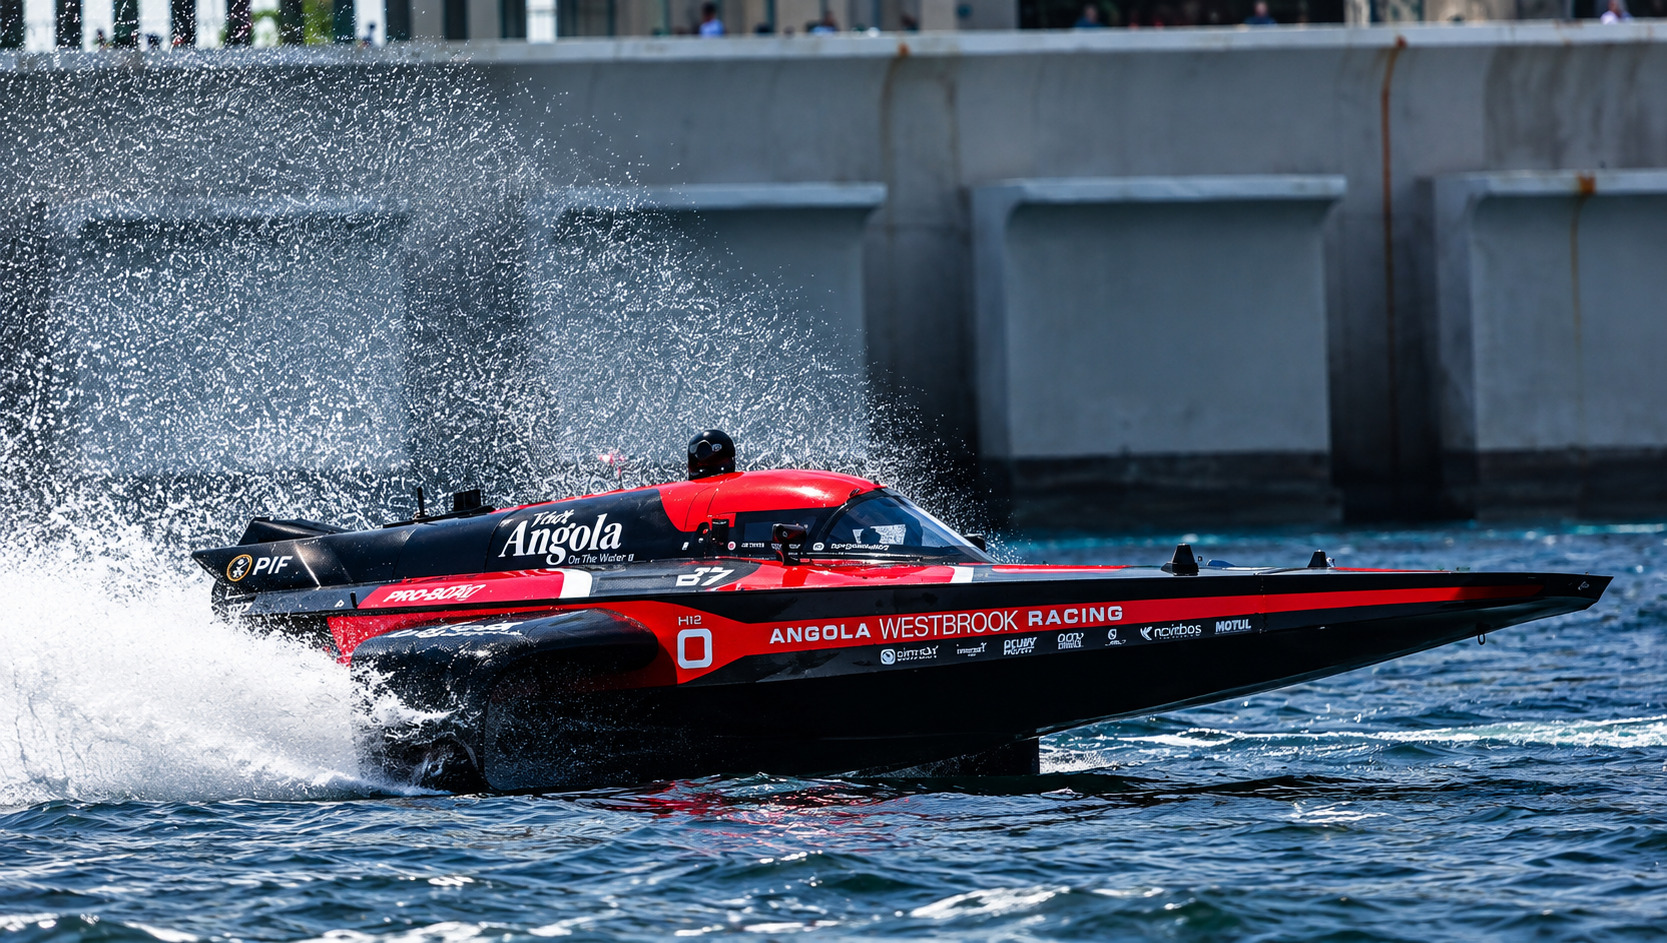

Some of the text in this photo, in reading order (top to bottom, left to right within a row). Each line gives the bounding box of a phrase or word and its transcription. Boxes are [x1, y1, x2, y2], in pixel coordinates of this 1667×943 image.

[498, 513, 623, 565] Angola
[252, 555, 293, 576] PIF
[568, 554, 581, 565] On
[581, 553, 598, 564] The
[599, 553, 627, 563] Water
[769, 605, 1123, 645] ANGOLA WESTBROOK RACING
[1215, 618, 1252, 633] MOTUL
